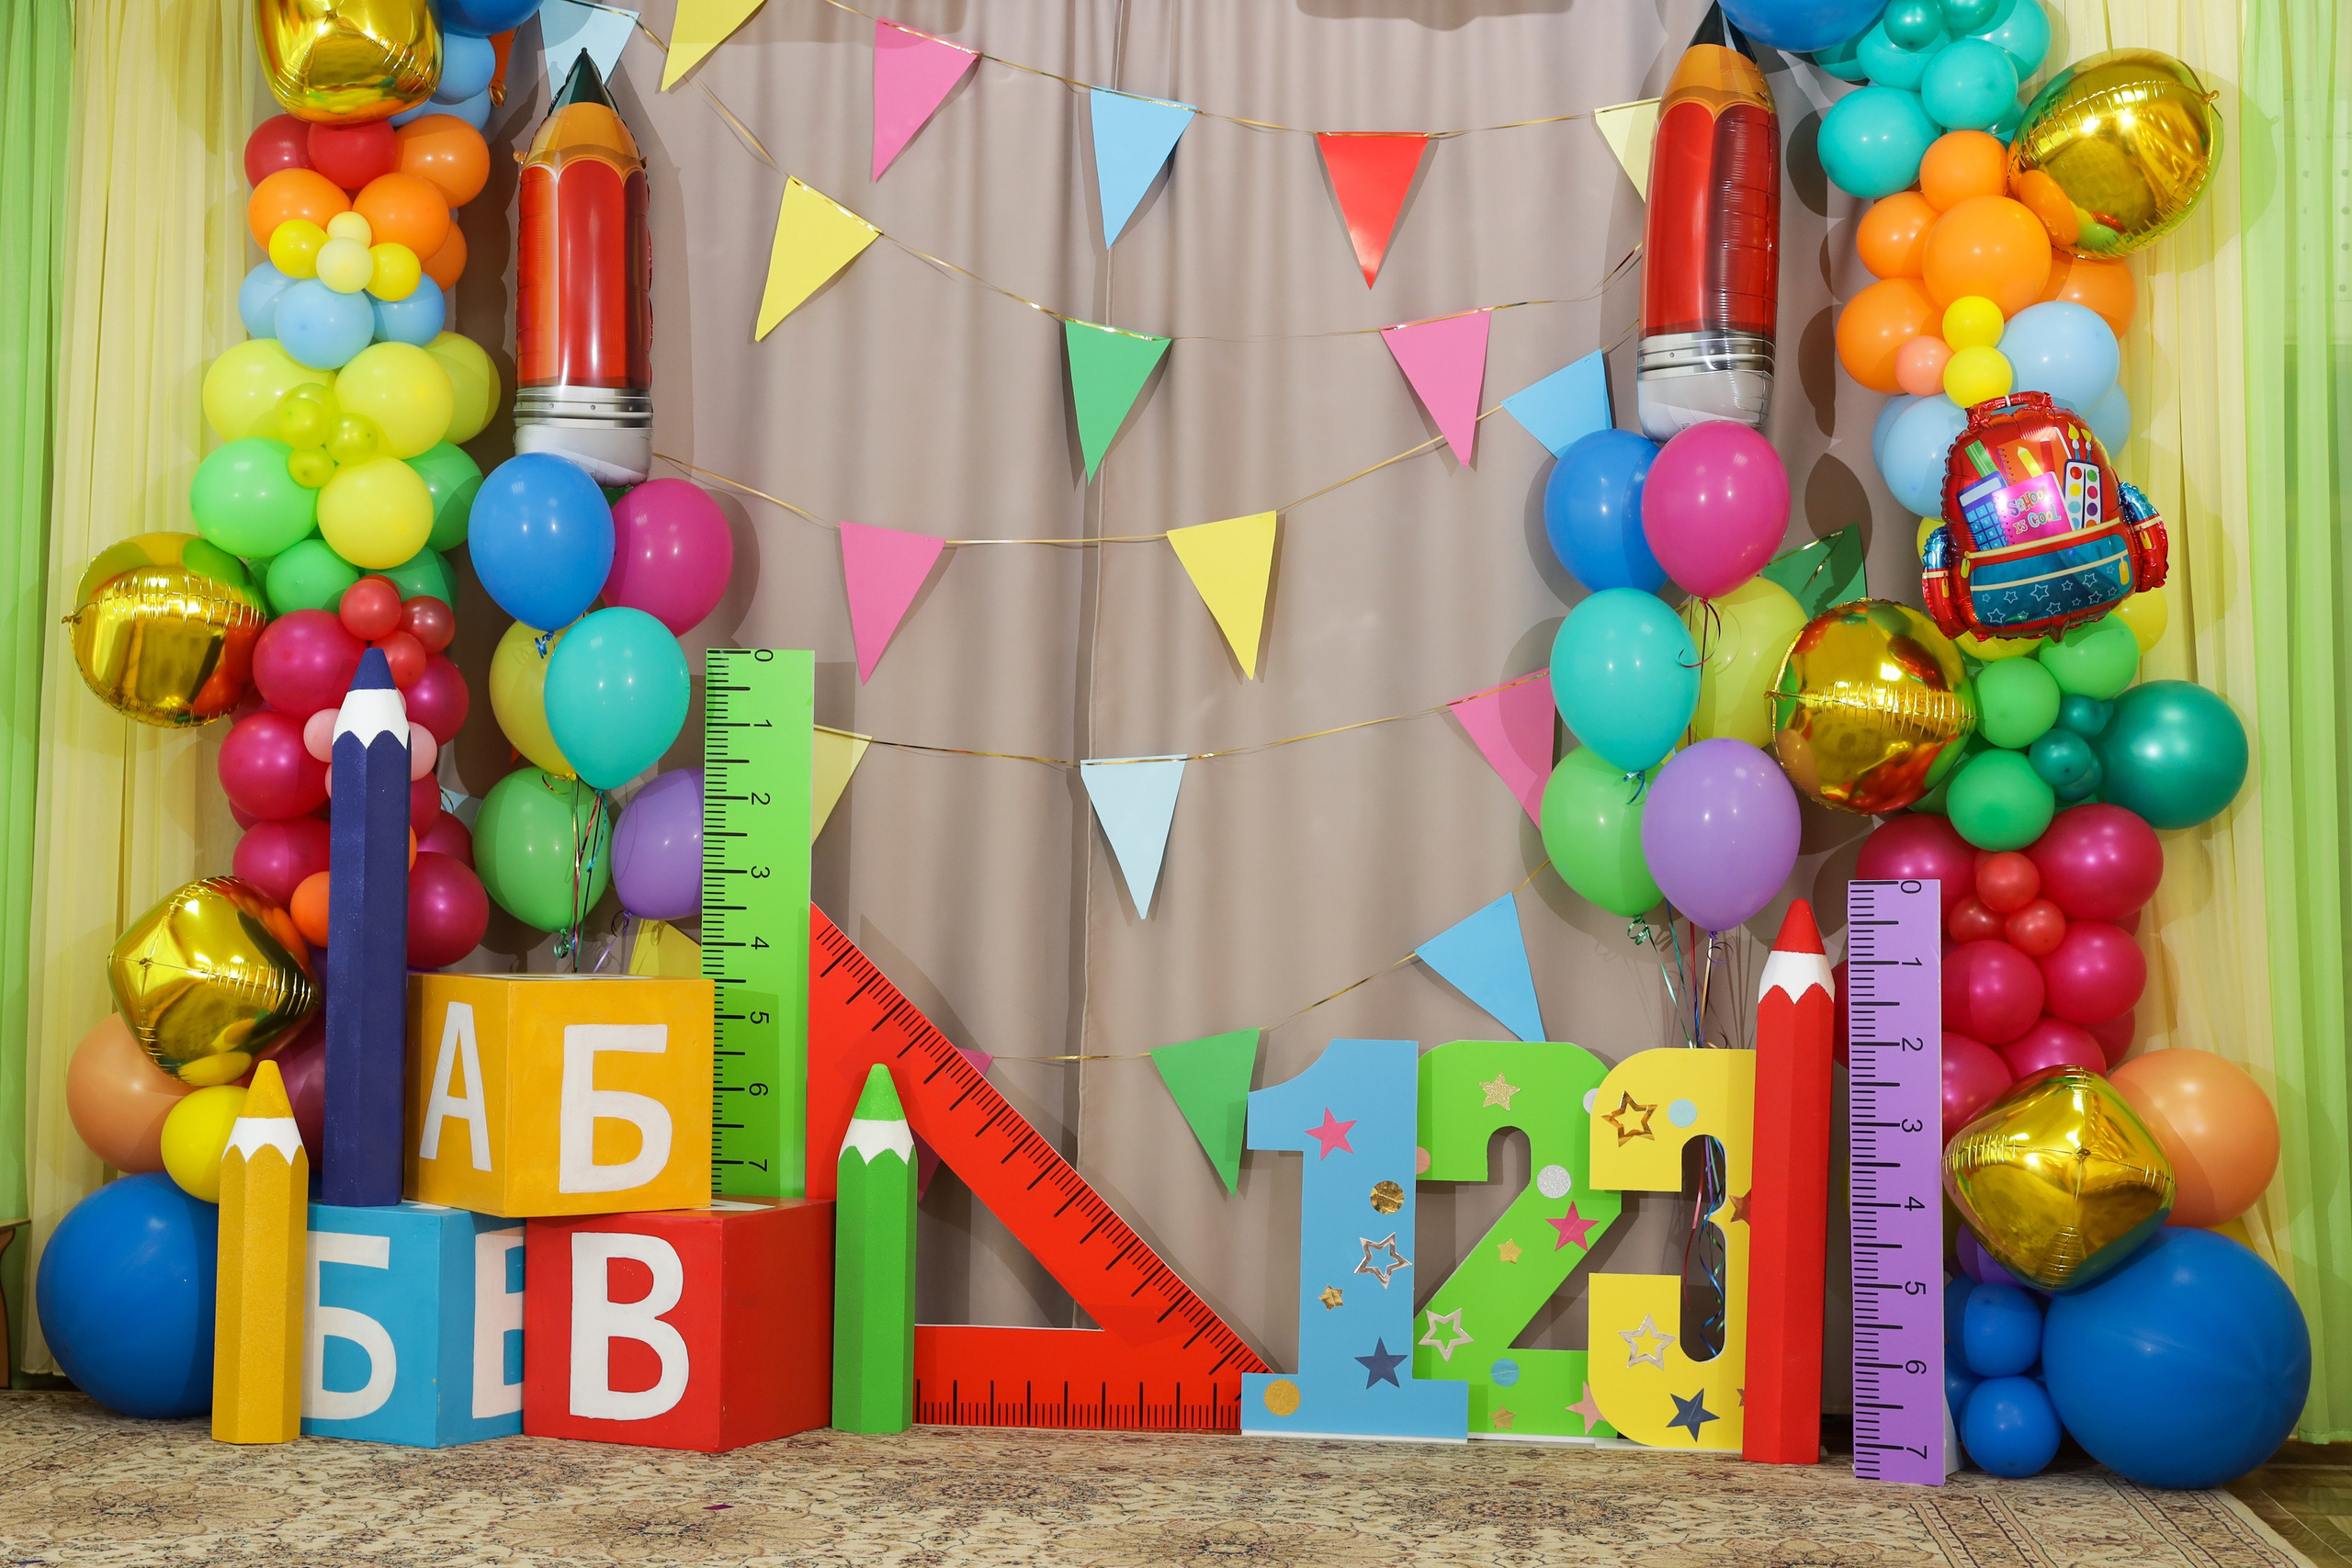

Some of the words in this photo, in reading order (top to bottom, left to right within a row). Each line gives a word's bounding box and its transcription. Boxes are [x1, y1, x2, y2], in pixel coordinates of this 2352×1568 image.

[2013, 519, 2029, 535] IS
[754, 649, 774, 662] 0
[753, 719, 773, 728] 1
[751, 792, 771, 806] 2
[751, 865, 770, 879] 3
[1900, 879, 1922, 895] 0
[750, 936, 770, 950] 4
[1901, 957, 1923, 966] 1
[750, 1010, 770, 1024] 5
[1902, 1037, 1923, 1052] 2
[749, 1082, 769, 1097] 6
[559, 1023, 673, 1193] Б
[1901, 1118, 1923, 1134] 3
[748, 1158, 768, 1172] 7
[1904, 1196, 1926, 1212] 4
[1905, 1280, 1927, 1296] 5
[300, 1230, 397, 1420] Б
[1905, 1359, 1928, 1375] 6
[1905, 1445, 1928, 1461] 7
